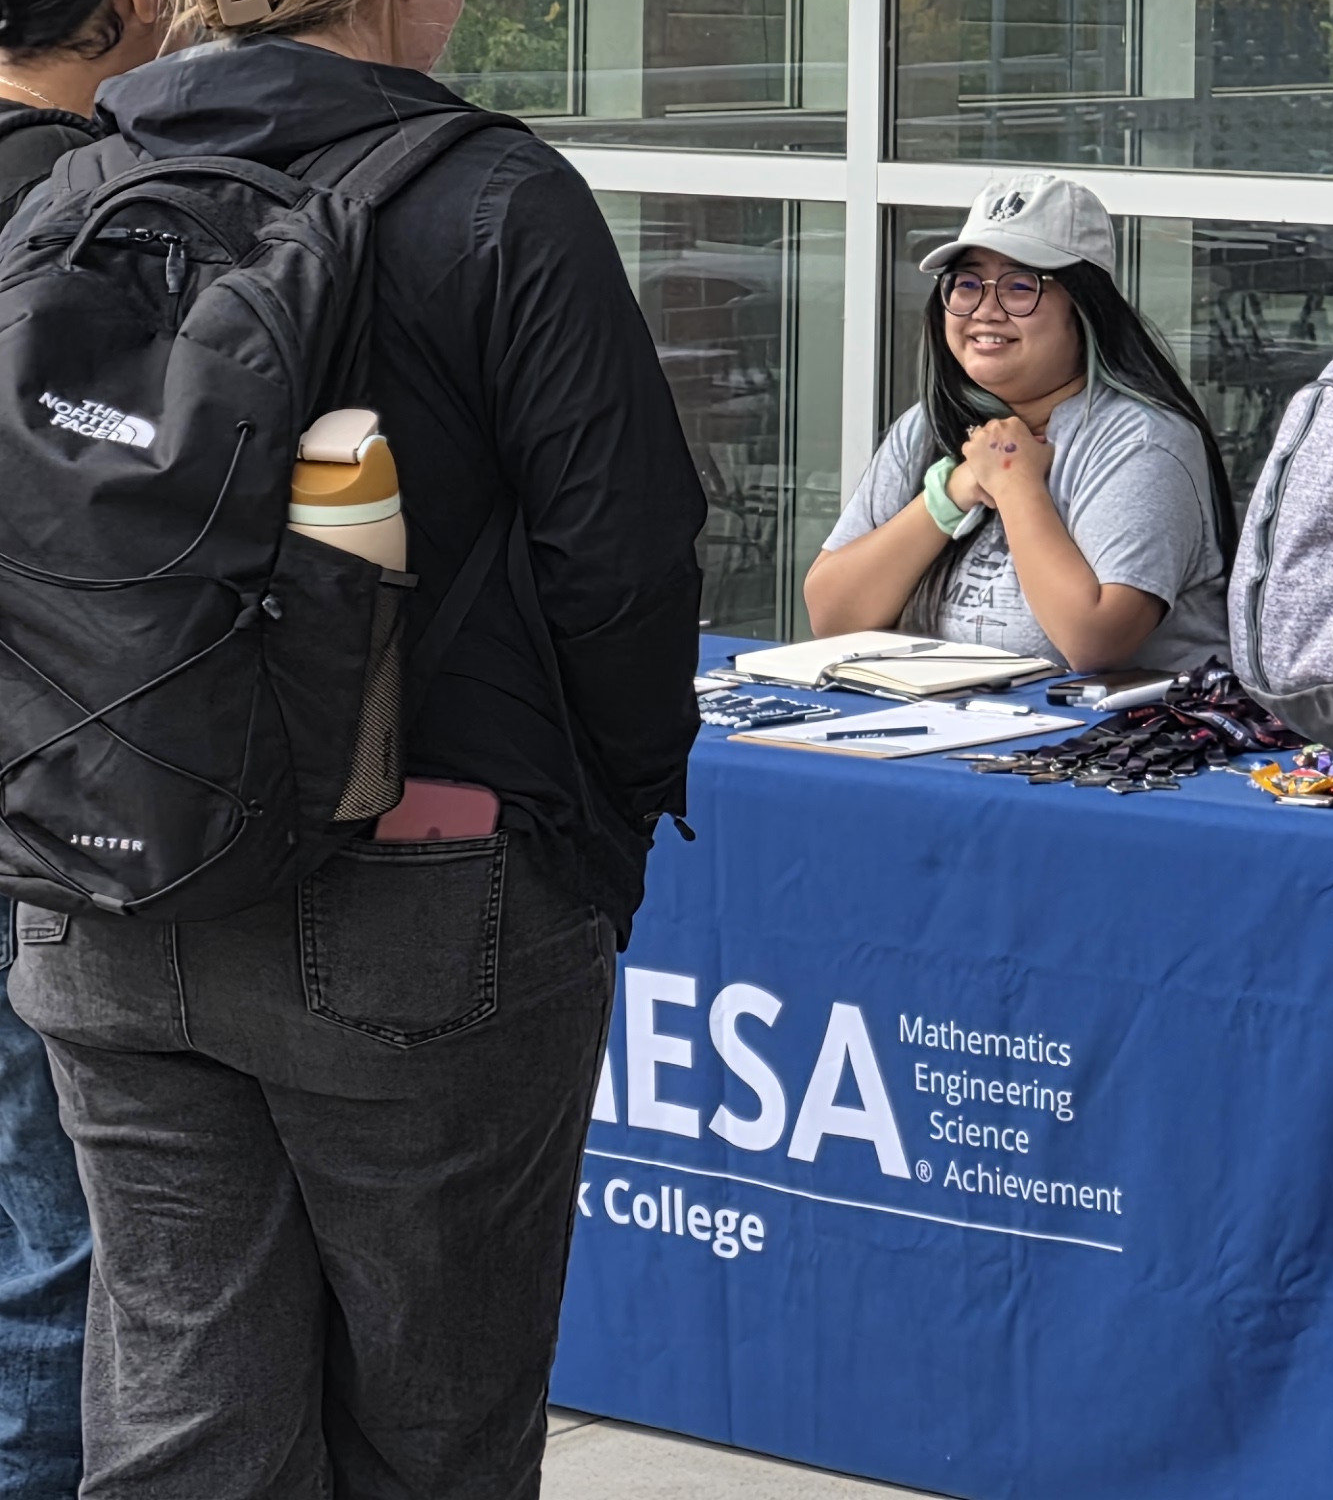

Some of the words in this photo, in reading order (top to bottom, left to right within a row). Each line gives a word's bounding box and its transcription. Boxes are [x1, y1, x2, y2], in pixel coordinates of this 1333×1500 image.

[38, 392, 119, 431] NORTH
[50, 413, 111, 439] FACE
[82, 399, 125, 421] THE
[70, 834, 143, 852] JESTER
[899, 1013, 1072, 1068] Mathematics
[915, 1062, 1074, 1122] Engineering
[929, 1111, 1030, 1155] Science
[943, 1160, 1122, 1215] Achievement
[603, 1178, 766, 1260] College
